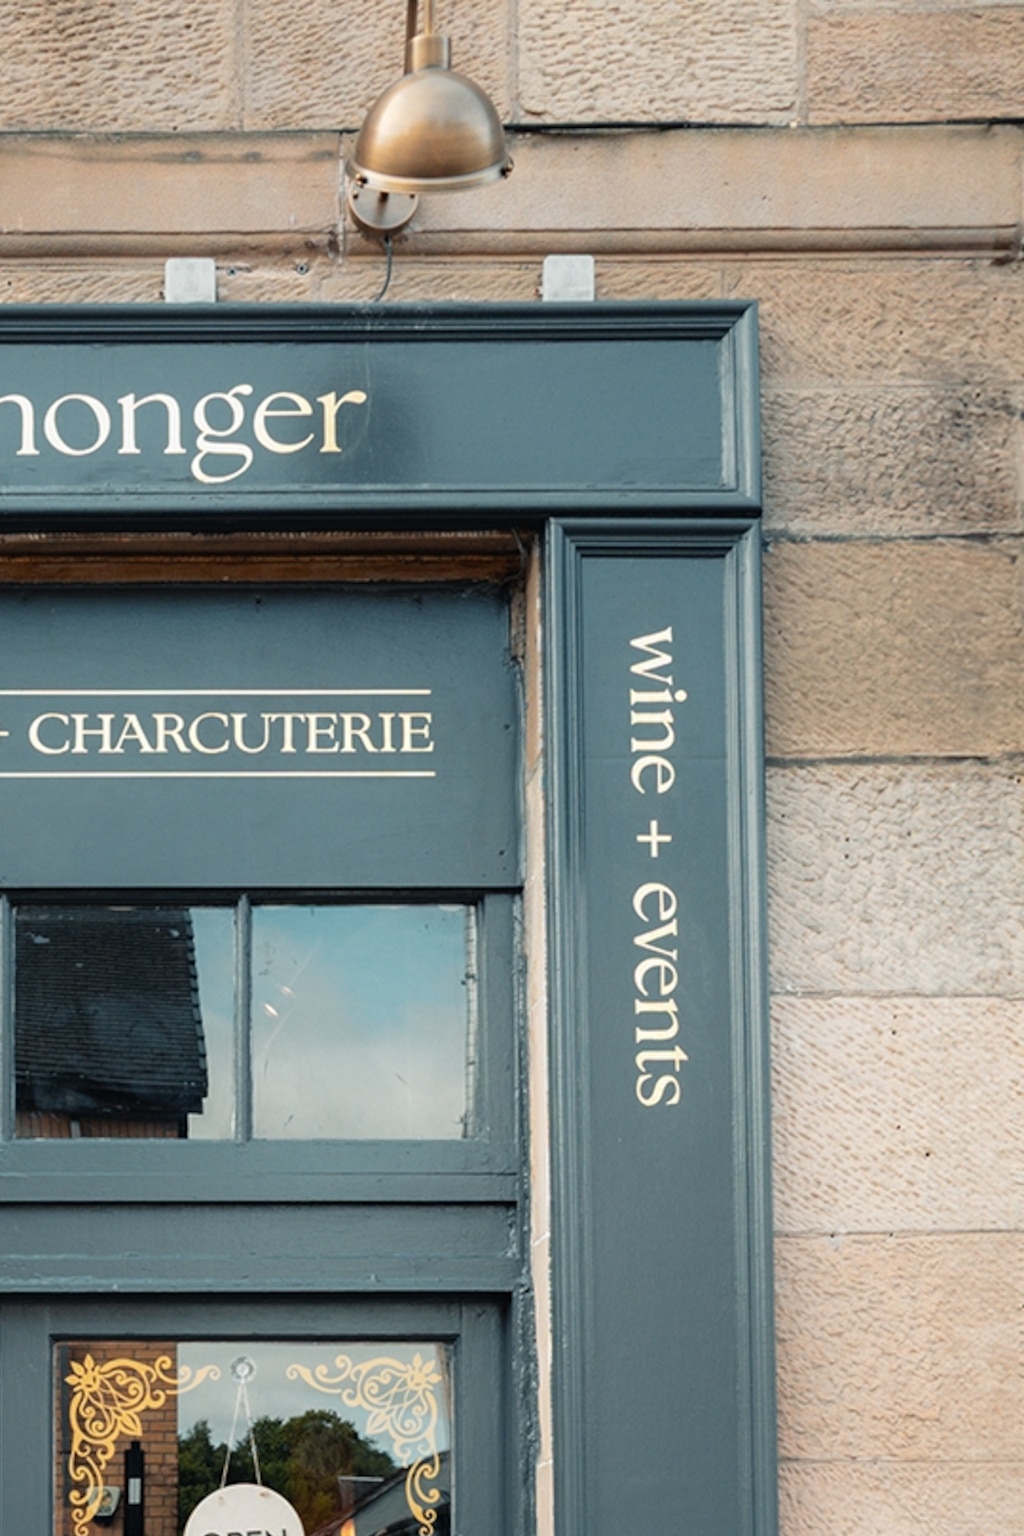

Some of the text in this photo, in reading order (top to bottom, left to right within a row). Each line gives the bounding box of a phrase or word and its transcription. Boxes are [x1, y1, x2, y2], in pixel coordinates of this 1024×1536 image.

[28, 712, 435, 755] CHARCUTERIE
[629, 626, 689, 1107] wine + events
